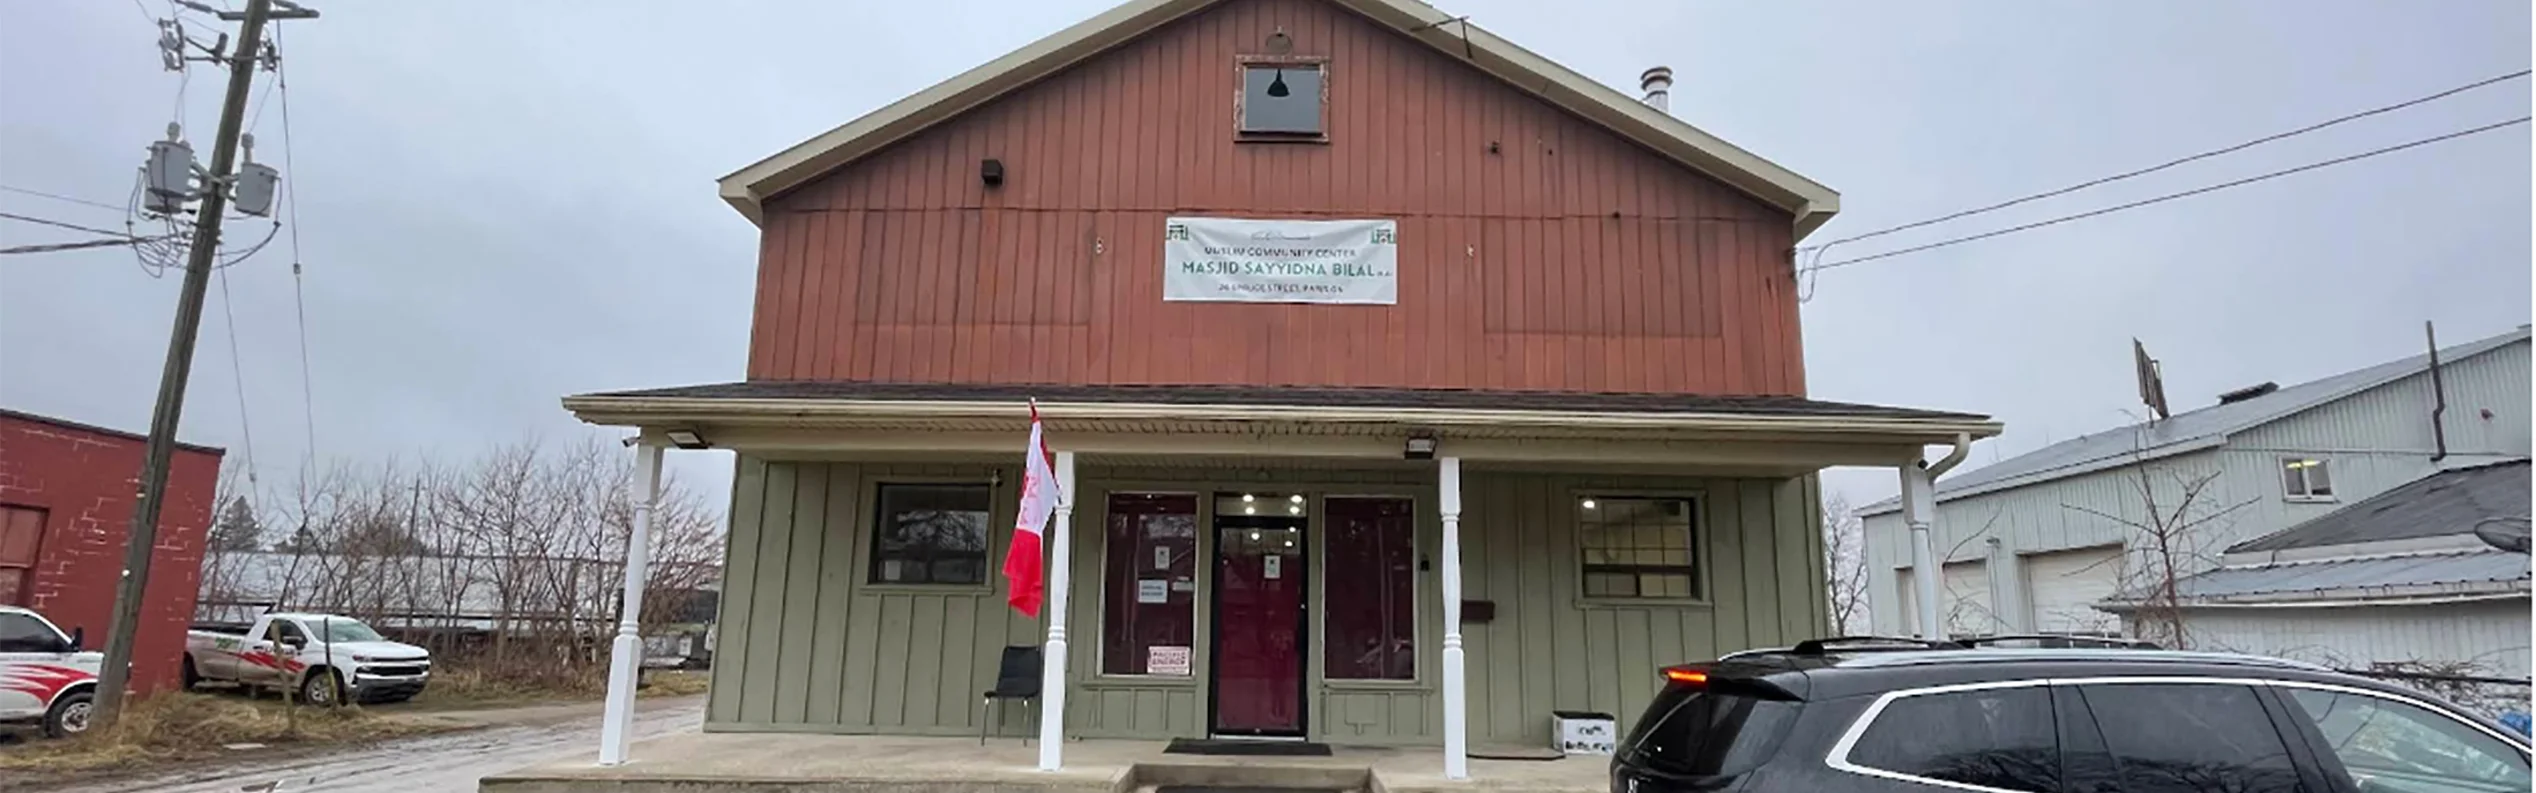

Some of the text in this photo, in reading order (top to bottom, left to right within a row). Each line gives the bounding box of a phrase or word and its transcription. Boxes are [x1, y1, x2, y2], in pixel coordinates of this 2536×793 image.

[1247, 247, 1313, 258] COMMUNITY
[1315, 249, 1356, 258] CENTER
[1182, 260, 1239, 275] MASJID
[1245, 261, 1327, 275] SAYYIDNA
[1332, 263, 1374, 277] BILAL
